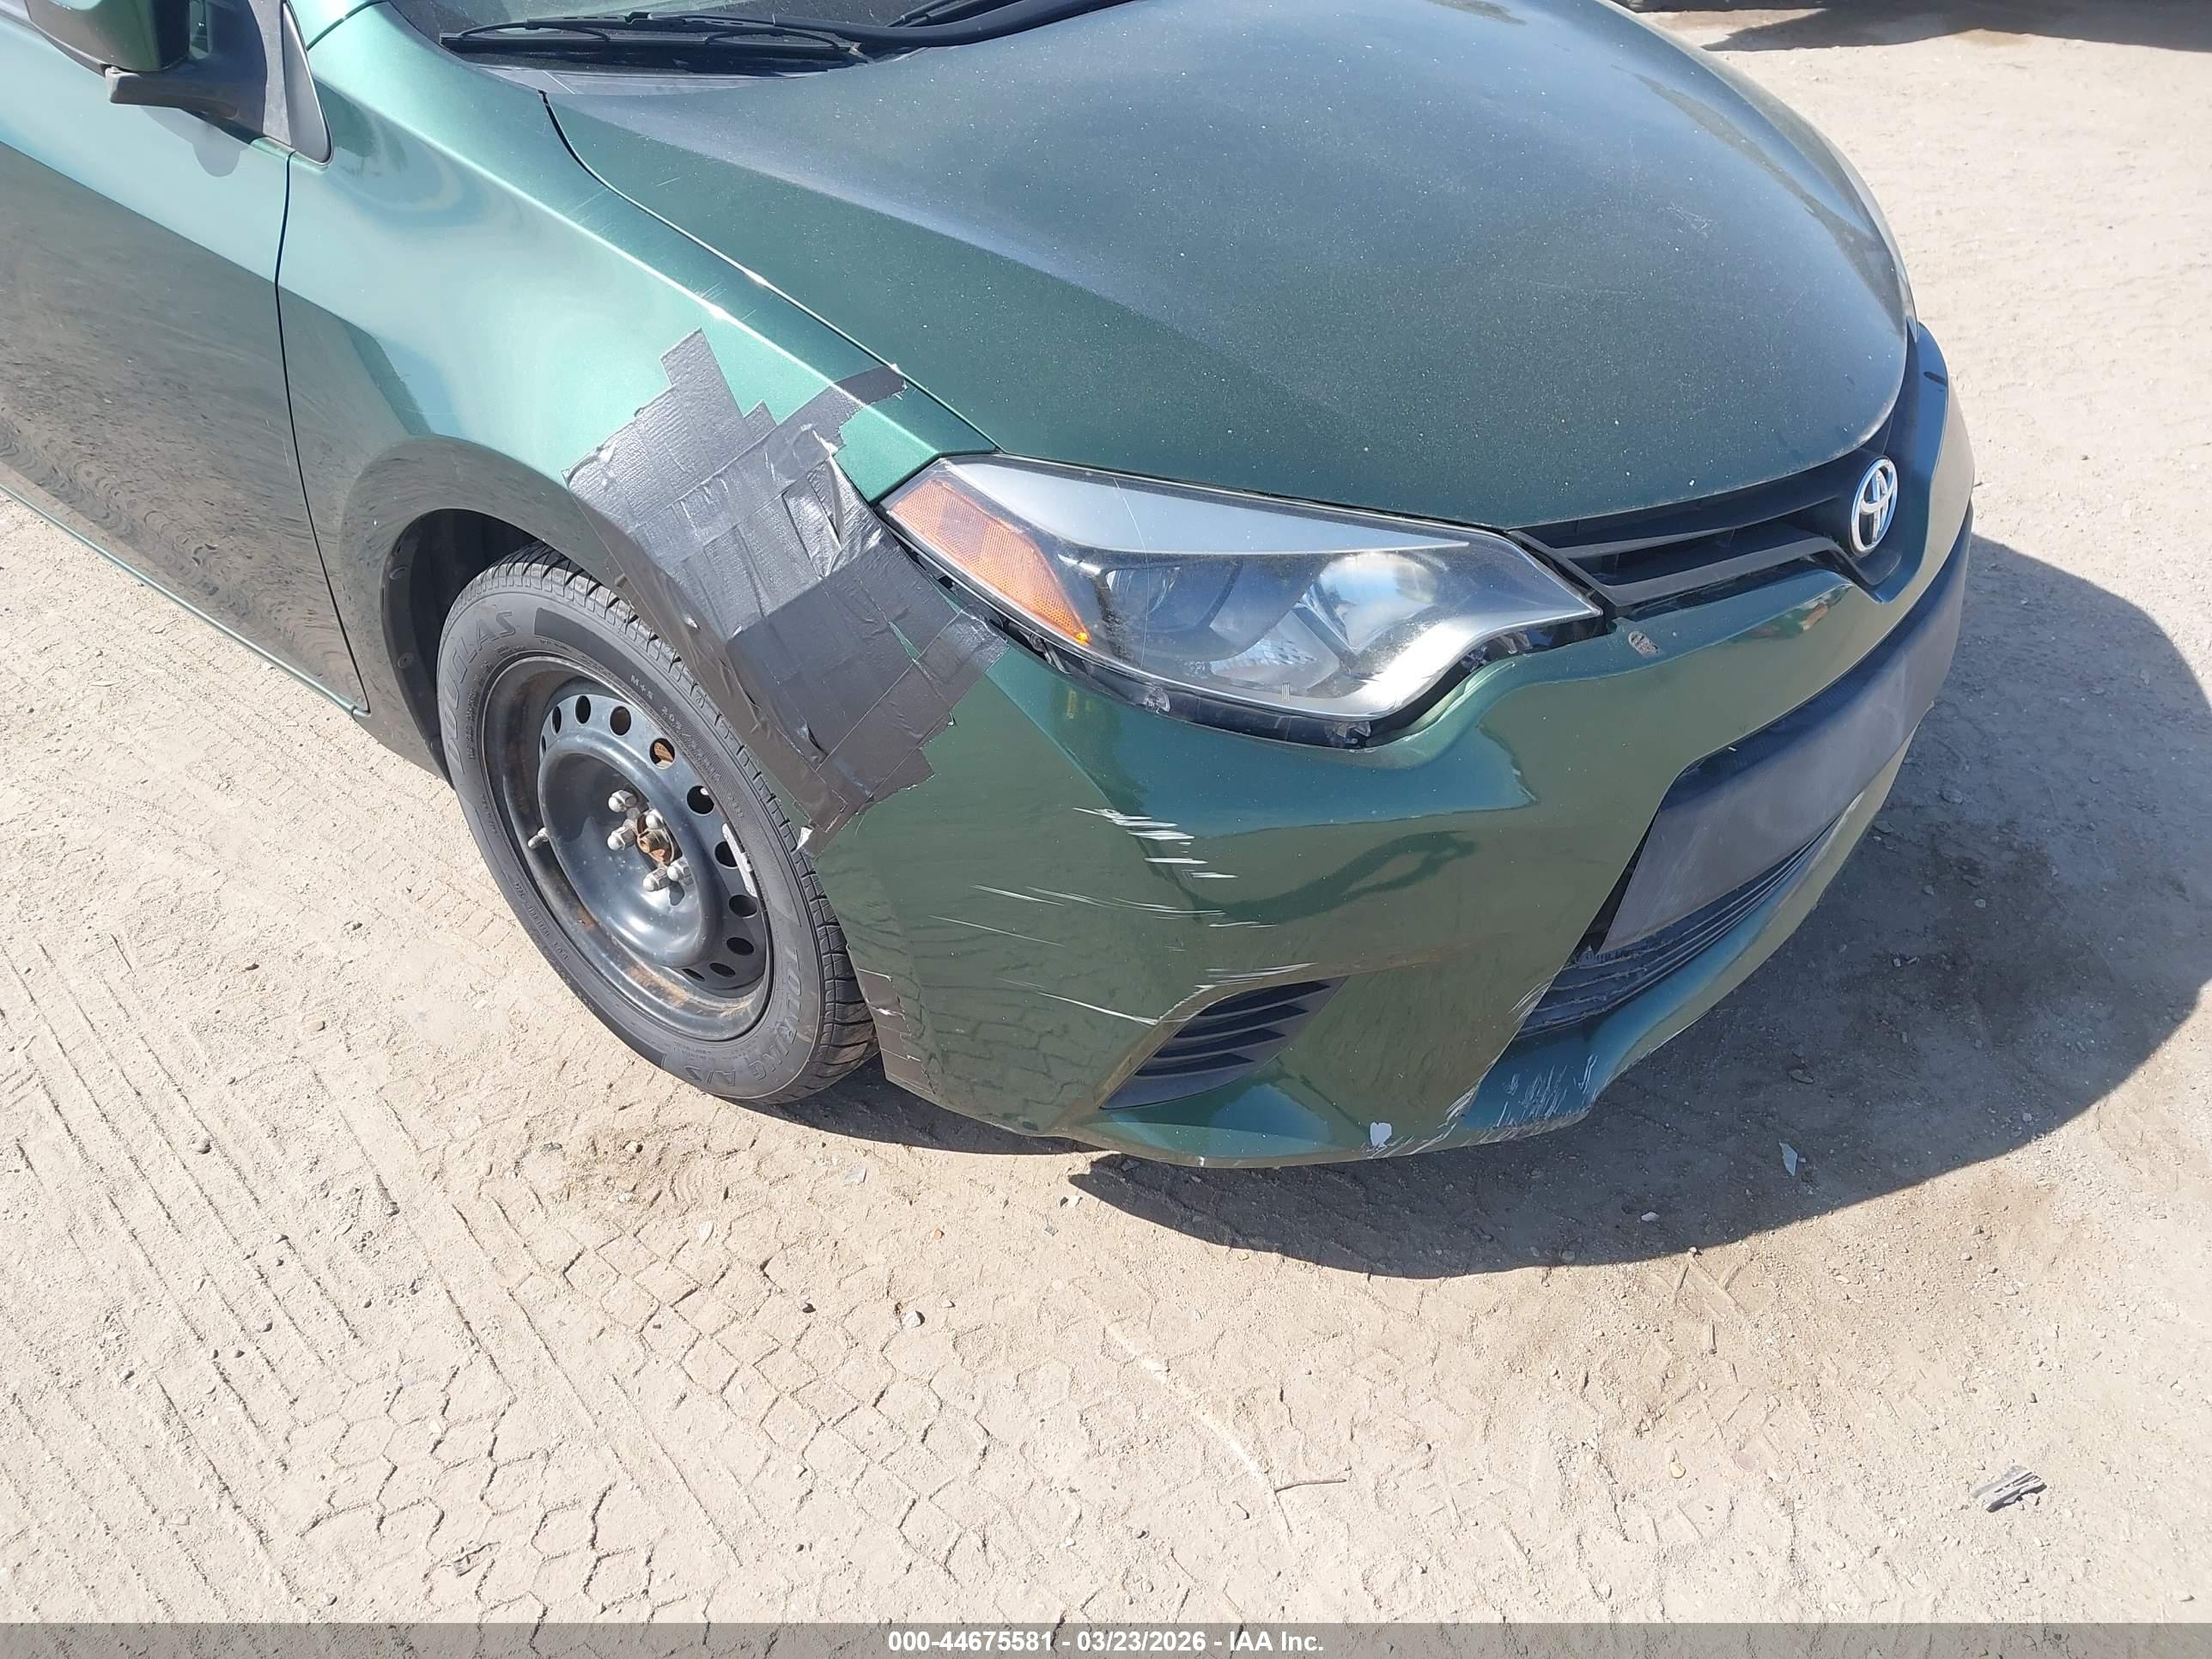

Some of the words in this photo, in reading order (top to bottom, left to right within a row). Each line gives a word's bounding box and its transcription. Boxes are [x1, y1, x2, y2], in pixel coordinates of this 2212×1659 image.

[444, 611, 516, 775] DOUGLAS
[629, 674, 654, 701] M+S
[749, 947, 802, 1081] TOURING
